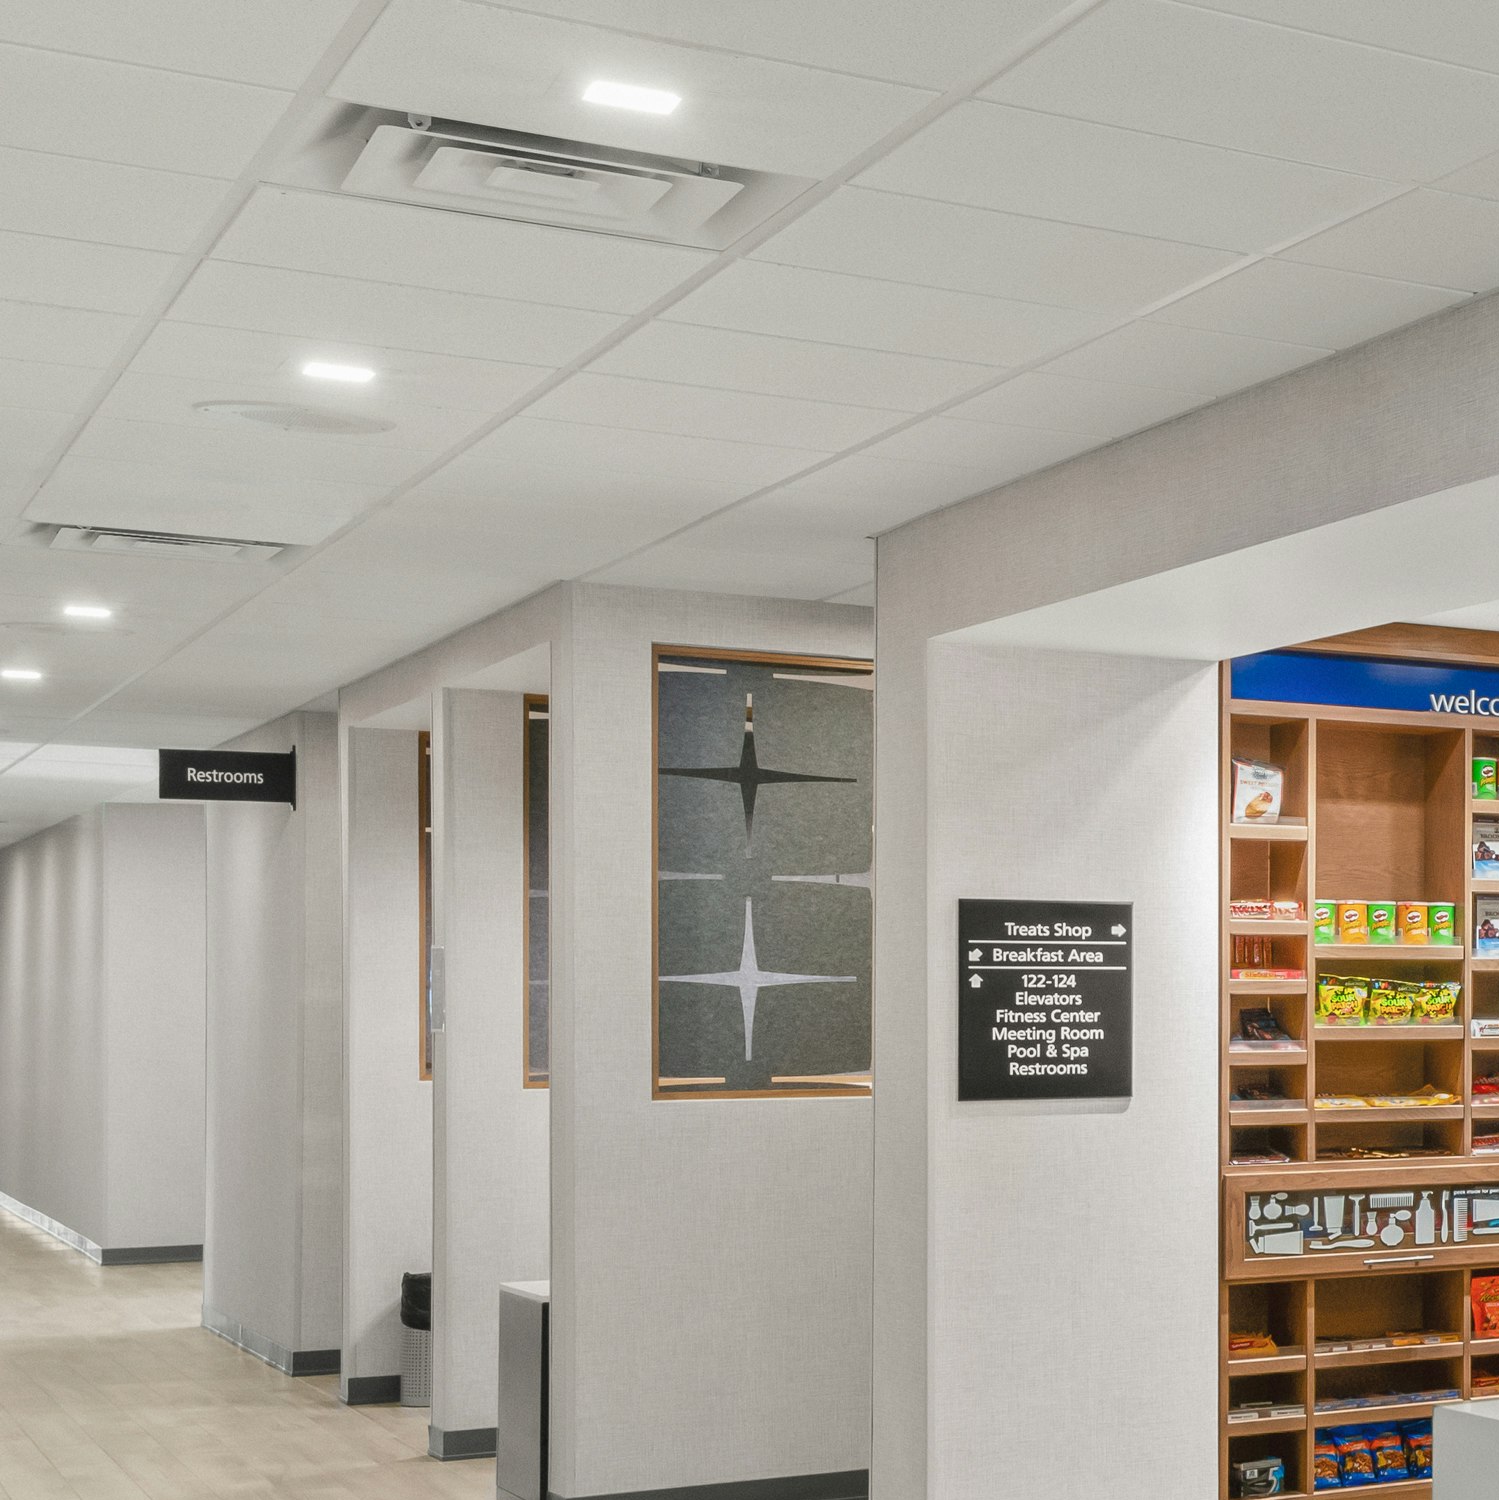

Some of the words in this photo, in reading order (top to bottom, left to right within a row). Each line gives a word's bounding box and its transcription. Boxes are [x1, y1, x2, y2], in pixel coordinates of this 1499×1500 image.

[186, 767, 265, 785] Restrooms
[1004, 922, 1050, 937] Treats
[1053, 922, 1093, 940] Shop
[992, 947, 1063, 963] Breakfast
[1067, 948, 1104, 963] Area
[1021, 974, 1077, 988] 122-124
[1015, 991, 1083, 1006] Elevators
[1331, 993, 1356, 1002] SOUR
[1380, 997, 1407, 1006] SOUR
[1427, 996, 1452, 1004] SOUR
[995, 1008, 1047, 1023] Fitness
[1050, 1008, 1102, 1023] Center
[991, 1026, 1056, 1043] Meeting
[1060, 1026, 1105, 1040] Room
[1007, 1044, 1041, 1058] Pool
[1046, 1044, 1058, 1058] &
[1061, 1044, 1089, 1061] Spa
[1009, 1061, 1088, 1076] Restrooms
